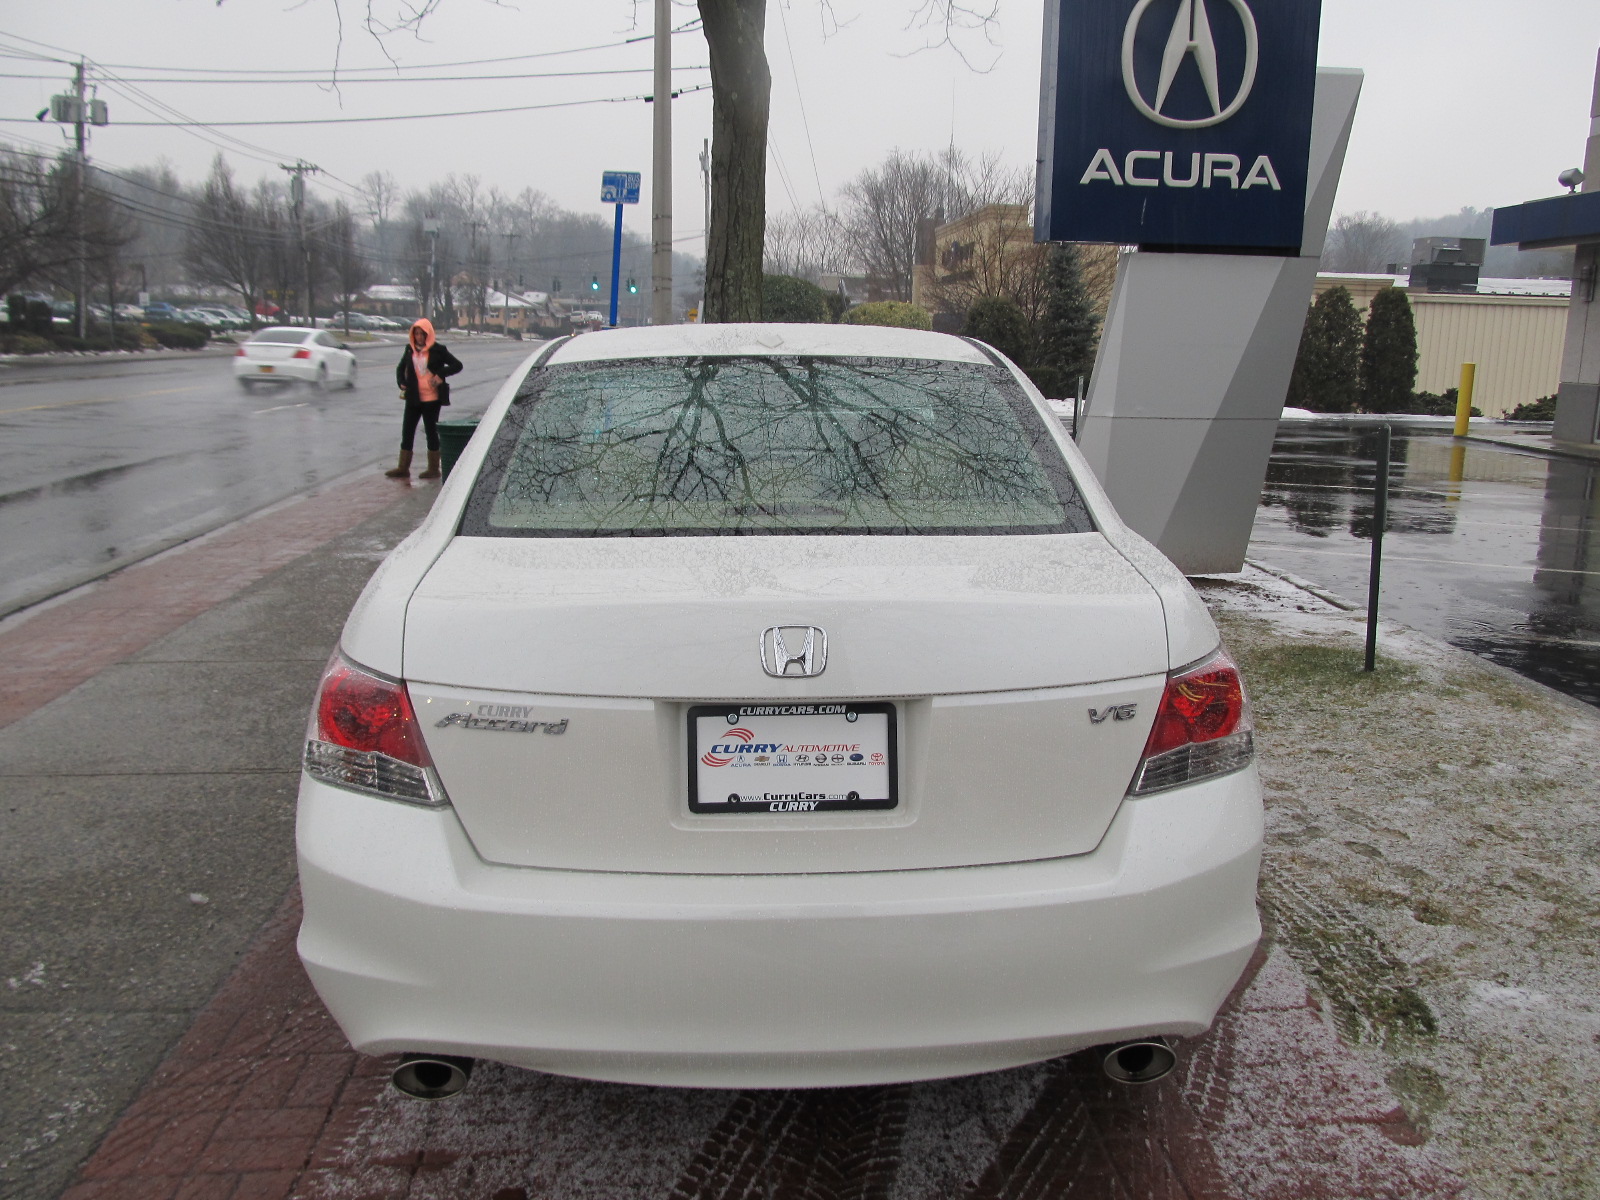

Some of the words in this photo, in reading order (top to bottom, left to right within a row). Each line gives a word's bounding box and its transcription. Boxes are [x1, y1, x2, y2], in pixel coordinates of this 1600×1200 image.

[1079, 148, 1281, 191] ACURA
[477, 705, 533, 718] CURRY
[739, 704, 847, 716] CURRYCARS.COM
[1088, 703, 1137, 724] V6
[434, 712, 569, 735] Accord
[710, 743, 783, 754] CURRY
[781, 743, 861, 753] AUTOMOTIVE
[740, 791, 847, 802] www.CurryCars.com
[769, 801, 818, 812] CURRY
